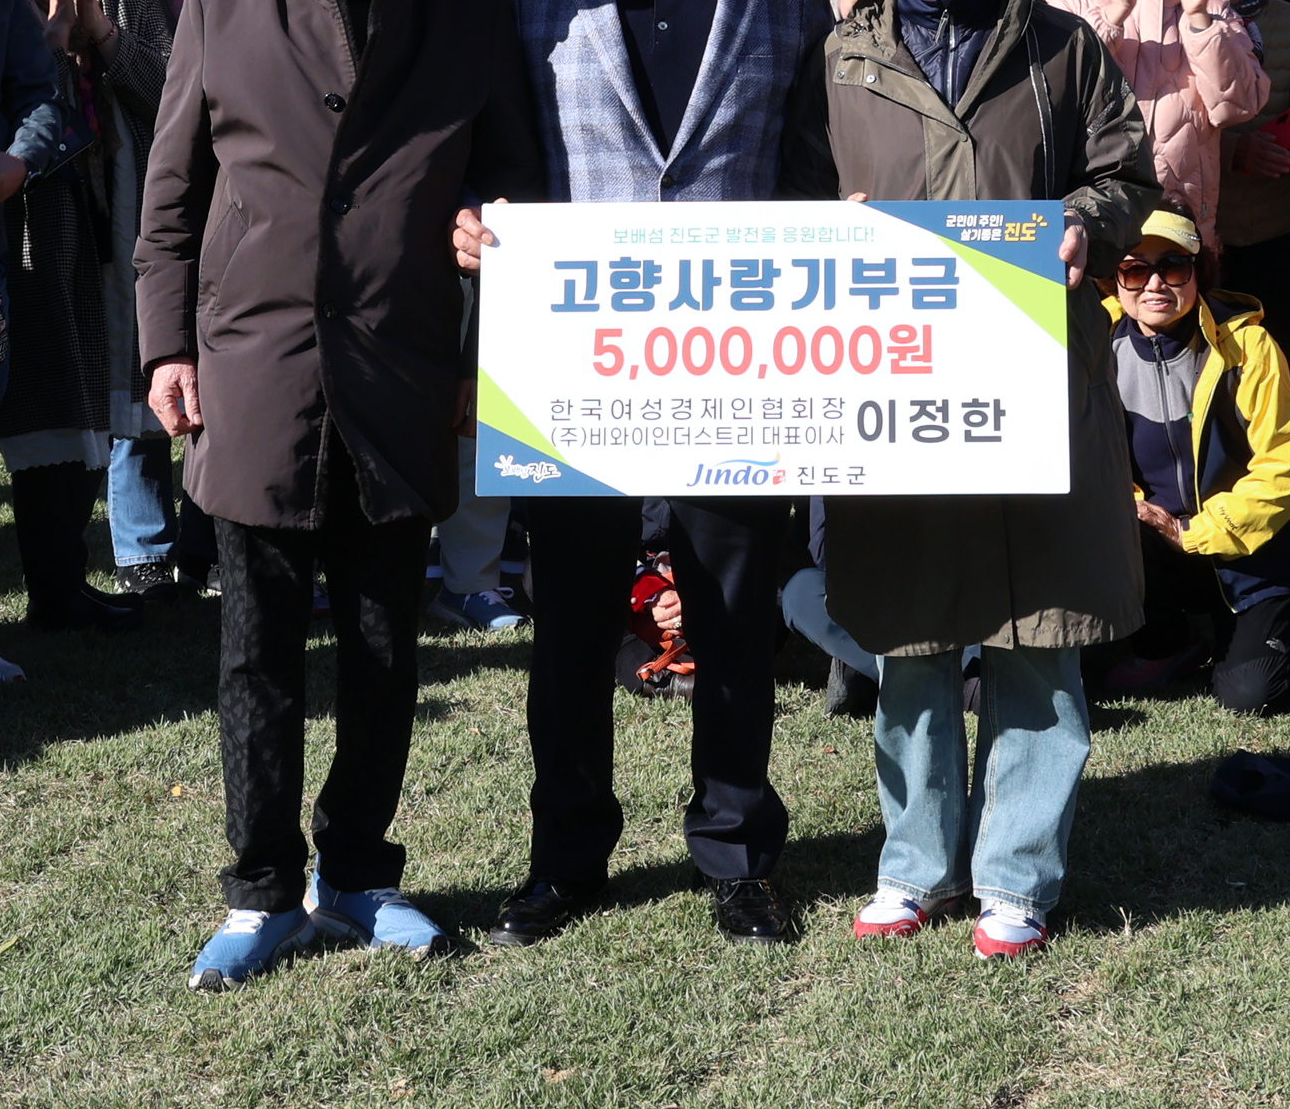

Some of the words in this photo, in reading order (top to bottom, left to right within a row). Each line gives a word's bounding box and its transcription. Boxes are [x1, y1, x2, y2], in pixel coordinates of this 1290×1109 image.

[946, 214, 978, 227] 군민이
[979, 214, 1004, 227] 주인!
[1004, 222, 1038, 242] 진도
[613, 228, 664, 244] 보배섬
[670, 227, 720, 244] 진도군
[726, 226, 777, 243] 발전을
[783, 226, 875, 243] 응원합니다!
[960, 228, 1002, 241] 살기좋은
[550, 256, 960, 313] 고향사랑기부금
[592, 323, 934, 381] 5,000,000원
[550, 397, 846, 422] 한국여성경제인협회장
[856, 397, 1007, 444] 이정한
[550, 426, 755, 448] (주)비와이인더스트리
[762, 425, 845, 446] 대표이사
[686, 463, 770, 487] Jindo
[796, 465, 867, 486] 진도군
